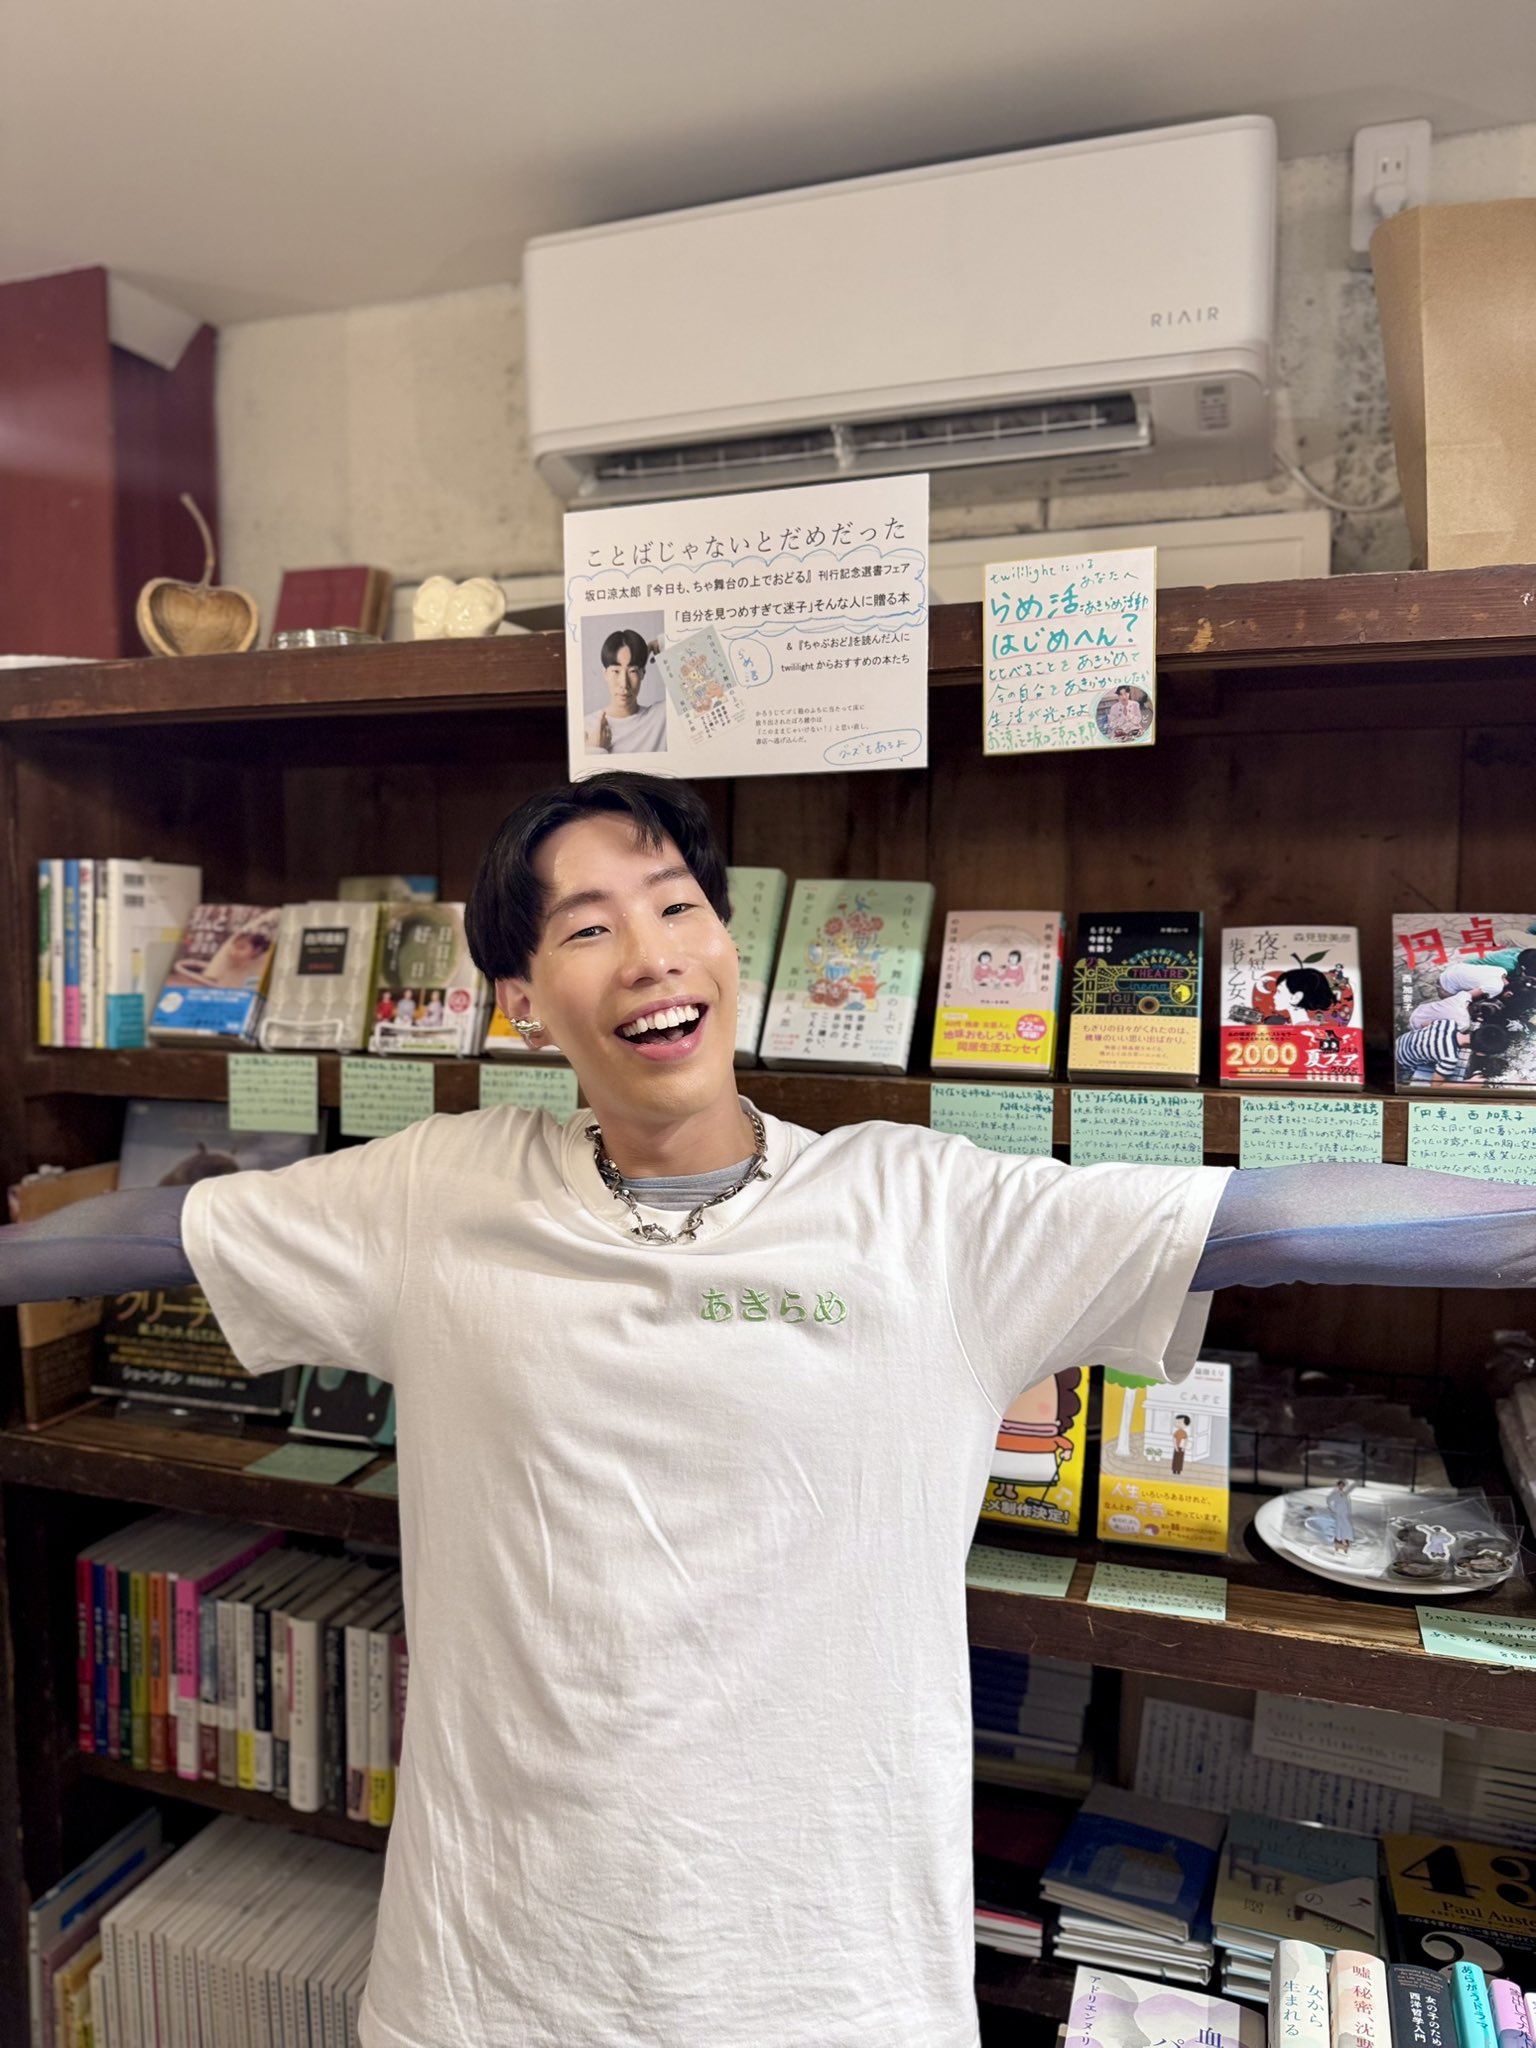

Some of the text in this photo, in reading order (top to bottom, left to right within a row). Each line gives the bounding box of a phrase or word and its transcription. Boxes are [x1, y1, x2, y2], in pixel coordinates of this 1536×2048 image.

[1150, 306, 1219, 328] RIAIR
[587, 516, 906, 568] ことばじゃないとだめだった
[1080, 571, 1140, 589] あなたへ
[675, 591, 911, 623] 「自分を見つめすぎて迷子」そんな人に贈る本
[816, 654, 911, 670] からおすすめの本たち
[1397, 916, 1507, 971] 円卓
[1132, 968, 1185, 979] THEATRE
[1226, 1041, 1298, 1066] 2000
[1303, 1048, 1360, 1069] 夏フェア
[701, 1287, 849, 1325] あきらめ
[1179, 1391, 1221, 1404] CAFE
[1442, 1901, 1484, 1918] Paul
[1282, 1980, 1301, 2037] 生まれる
[1305, 1983, 1325, 2029] 女から
